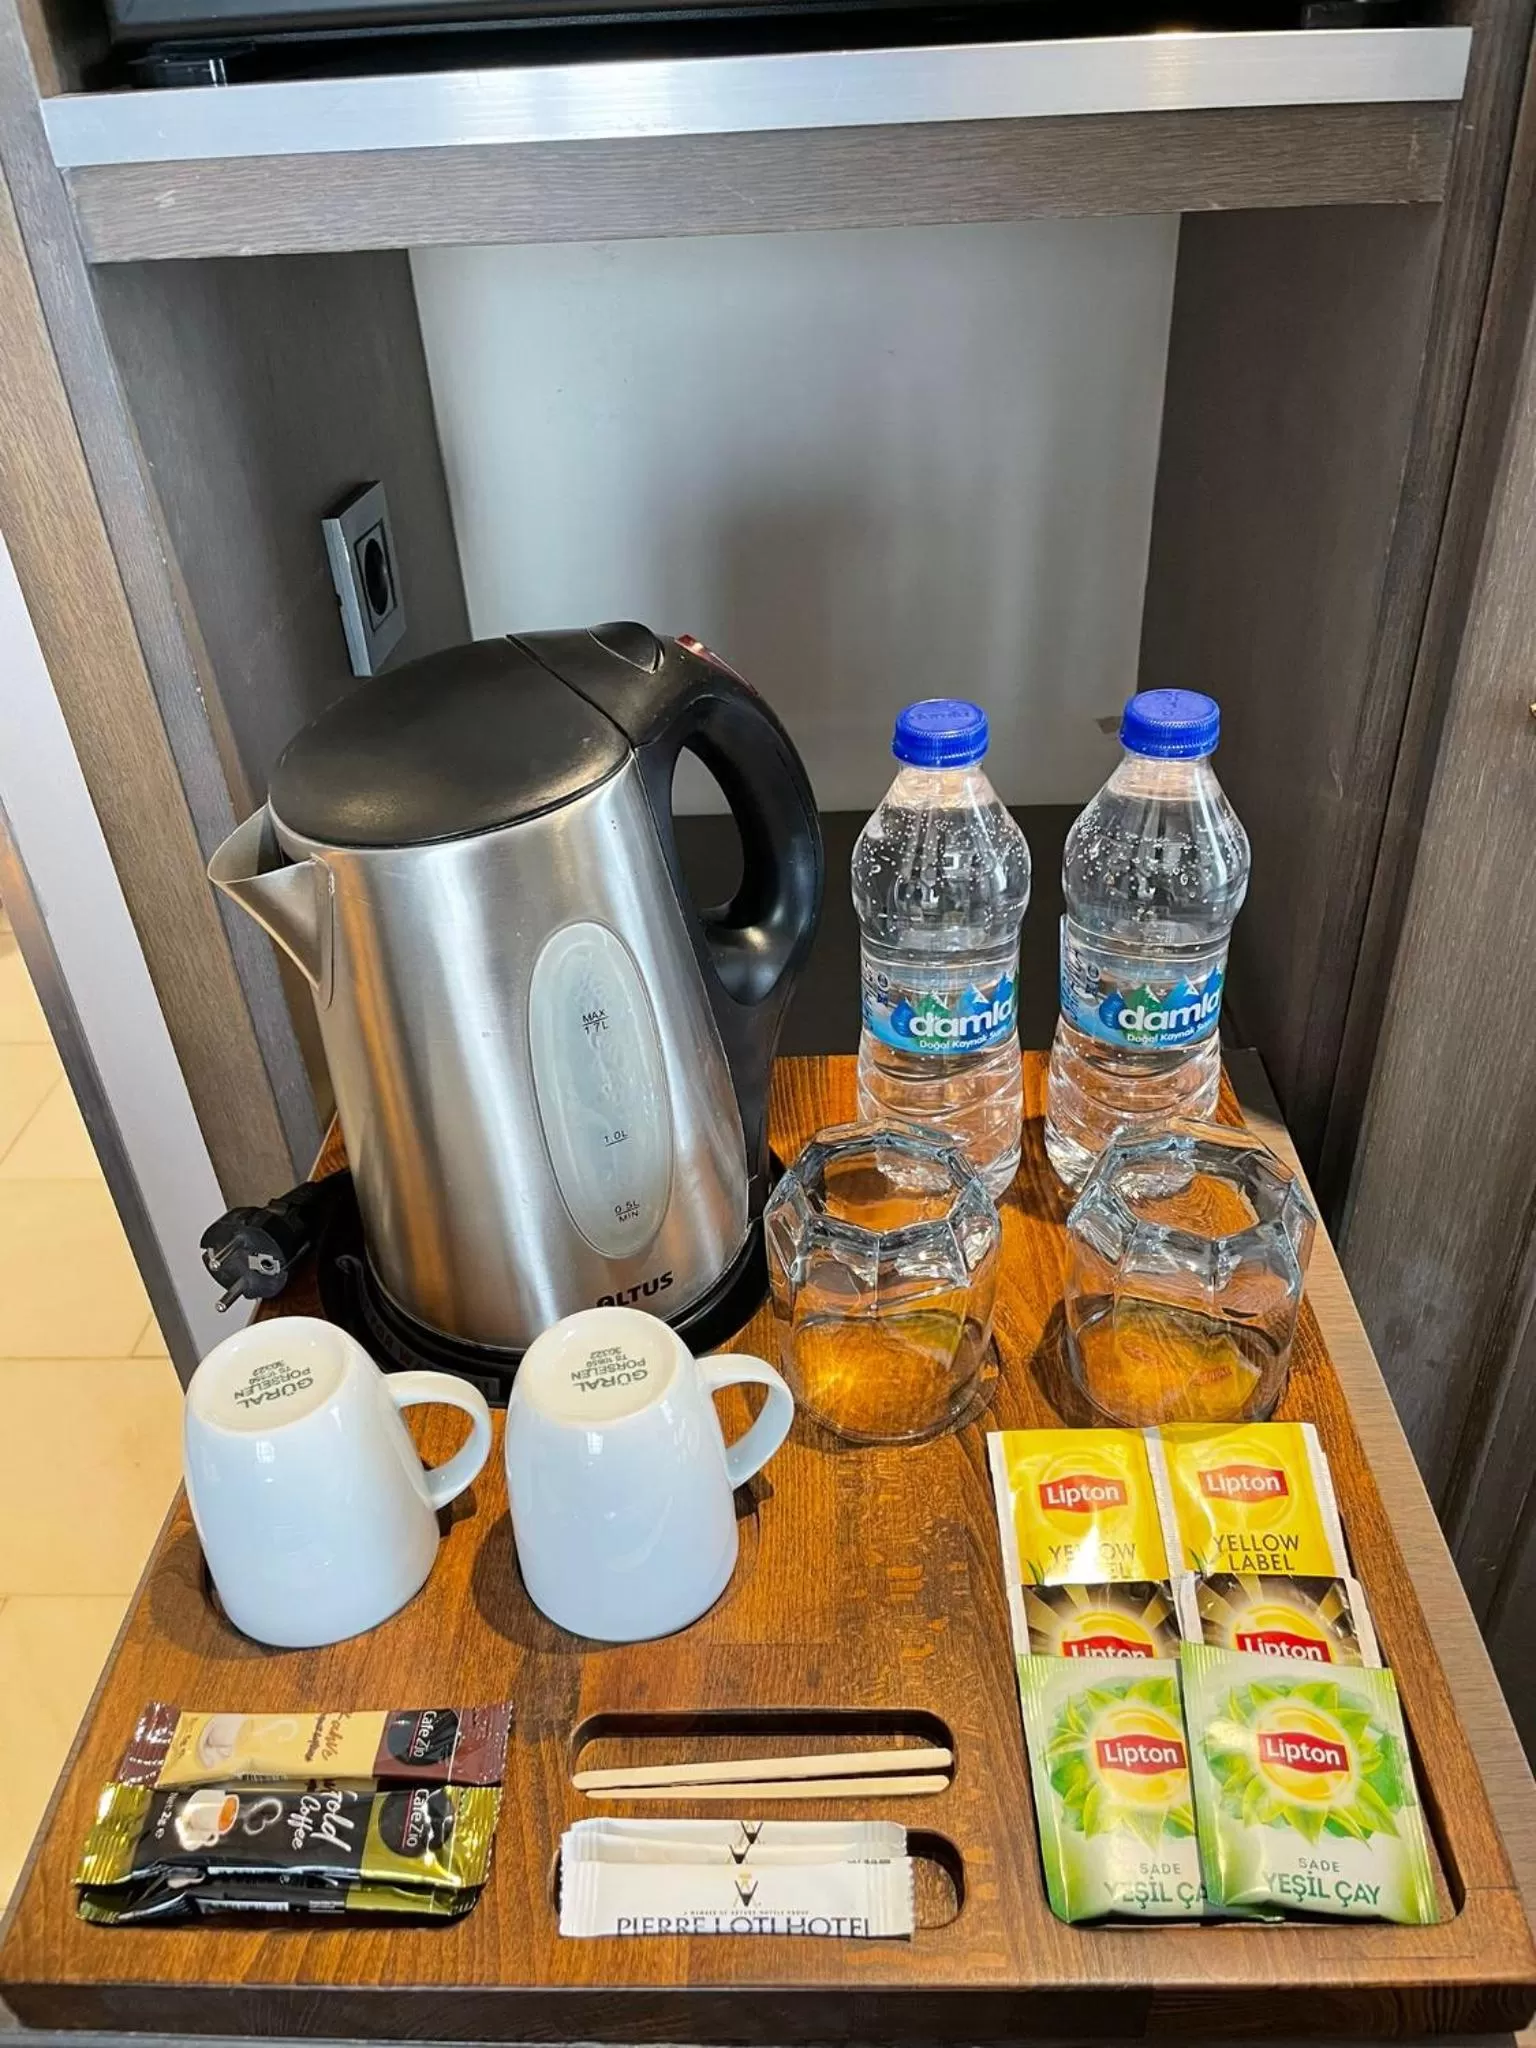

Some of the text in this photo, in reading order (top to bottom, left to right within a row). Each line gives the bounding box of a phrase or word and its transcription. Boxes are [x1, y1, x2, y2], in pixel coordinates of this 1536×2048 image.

[582, 1008, 606, 1023] MAX
[618, 1209, 639, 1223] MIN
[596, 1270, 674, 1307] ALTUS
[571, 1357, 646, 1381] PORSELEN
[572, 1369, 648, 1392] GÜRAL
[234, 1366, 311, 1400] PORSELEN
[236, 1377, 314, 1408] GÜRAL
[1206, 1471, 1283, 1496] Lipton
[1046, 1485, 1121, 1508] Lipton
[1048, 1543, 1136, 1563] YEOW
[1213, 1533, 1300, 1553] YELLOW
[1229, 1553, 1296, 1572] LABEL
[1243, 1638, 1324, 1661] Lipton
[1104, 1743, 1178, 1767] Lipton
[1265, 1737, 1341, 1767] Lipton
[286, 1795, 321, 1851] Coffee
[1139, 1862, 1182, 1875] SADE
[1297, 1857, 1341, 1873] SADE
[1265, 1870, 1382, 1906] YEŞİL ÇAY
[617, 1917, 706, 1935] PIERRE
